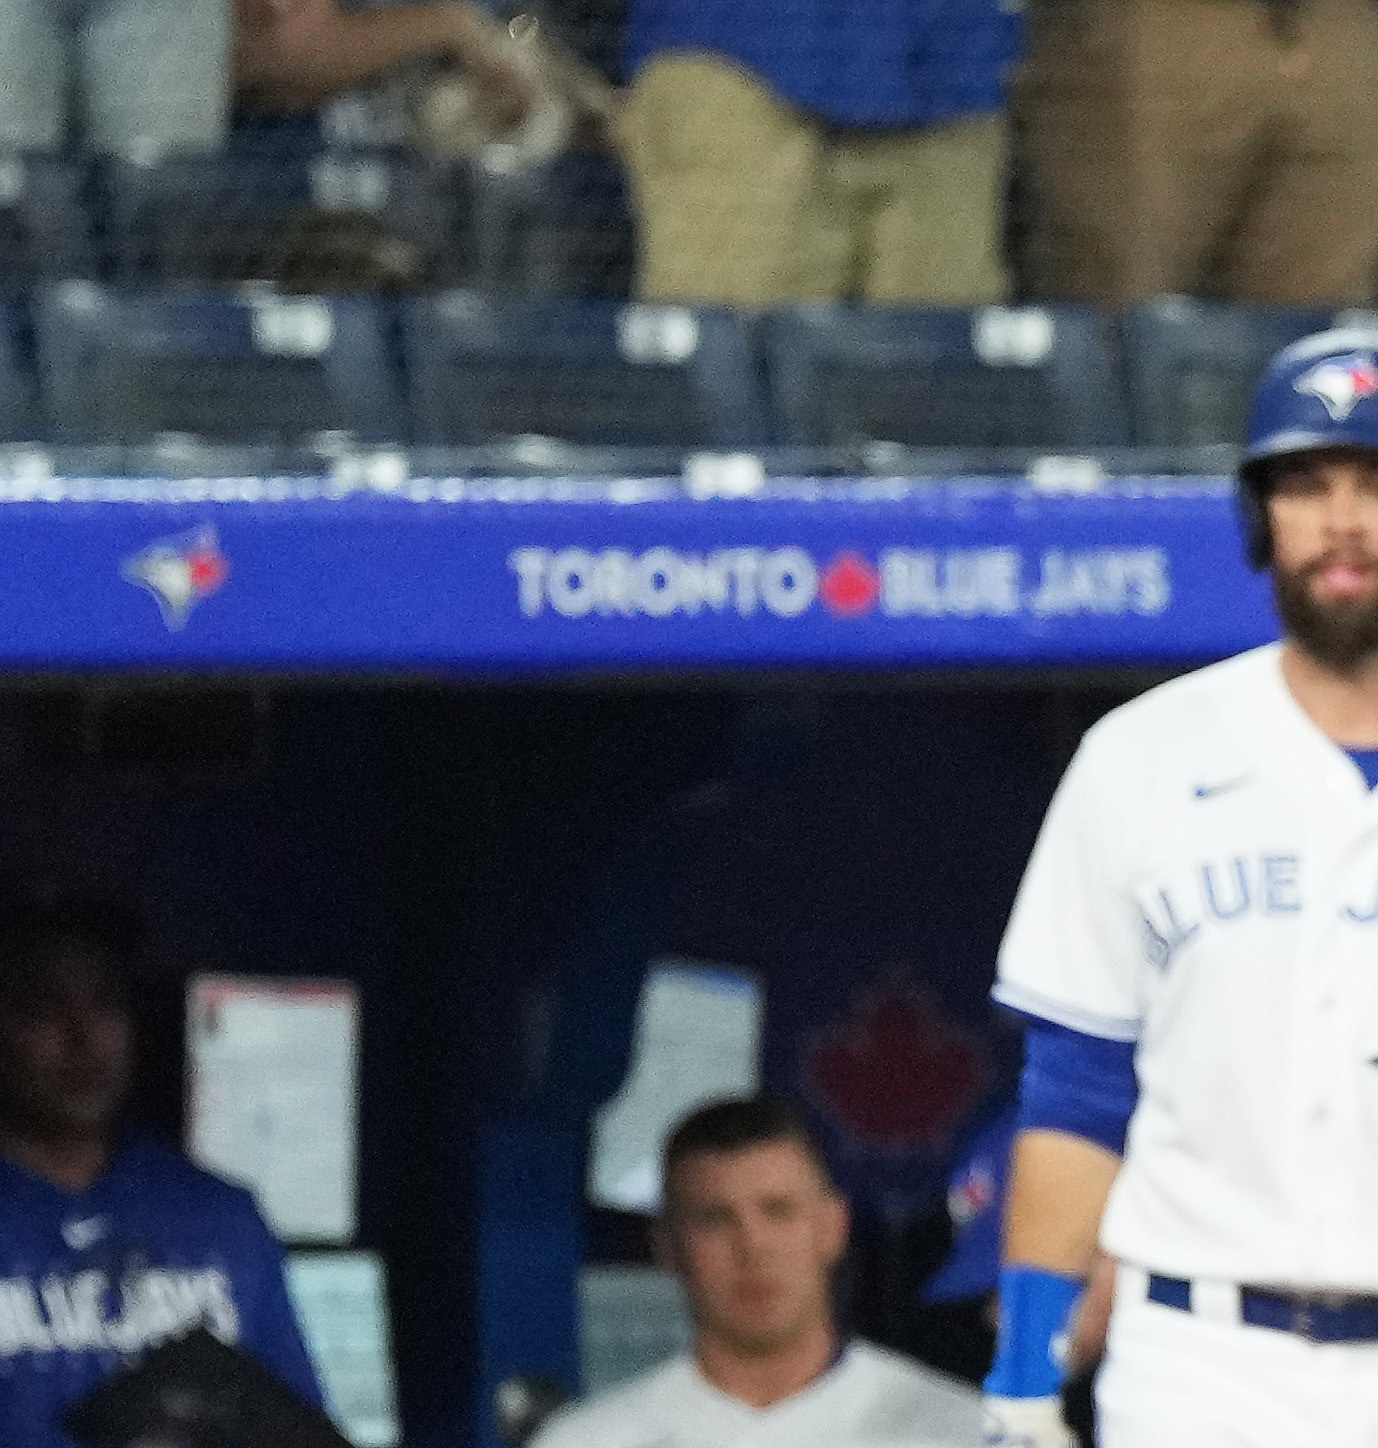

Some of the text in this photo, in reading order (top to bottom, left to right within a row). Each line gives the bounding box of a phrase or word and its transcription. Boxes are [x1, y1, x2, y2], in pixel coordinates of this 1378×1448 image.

[508, 545, 1170, 618] TORONTO BLUE JAYS
